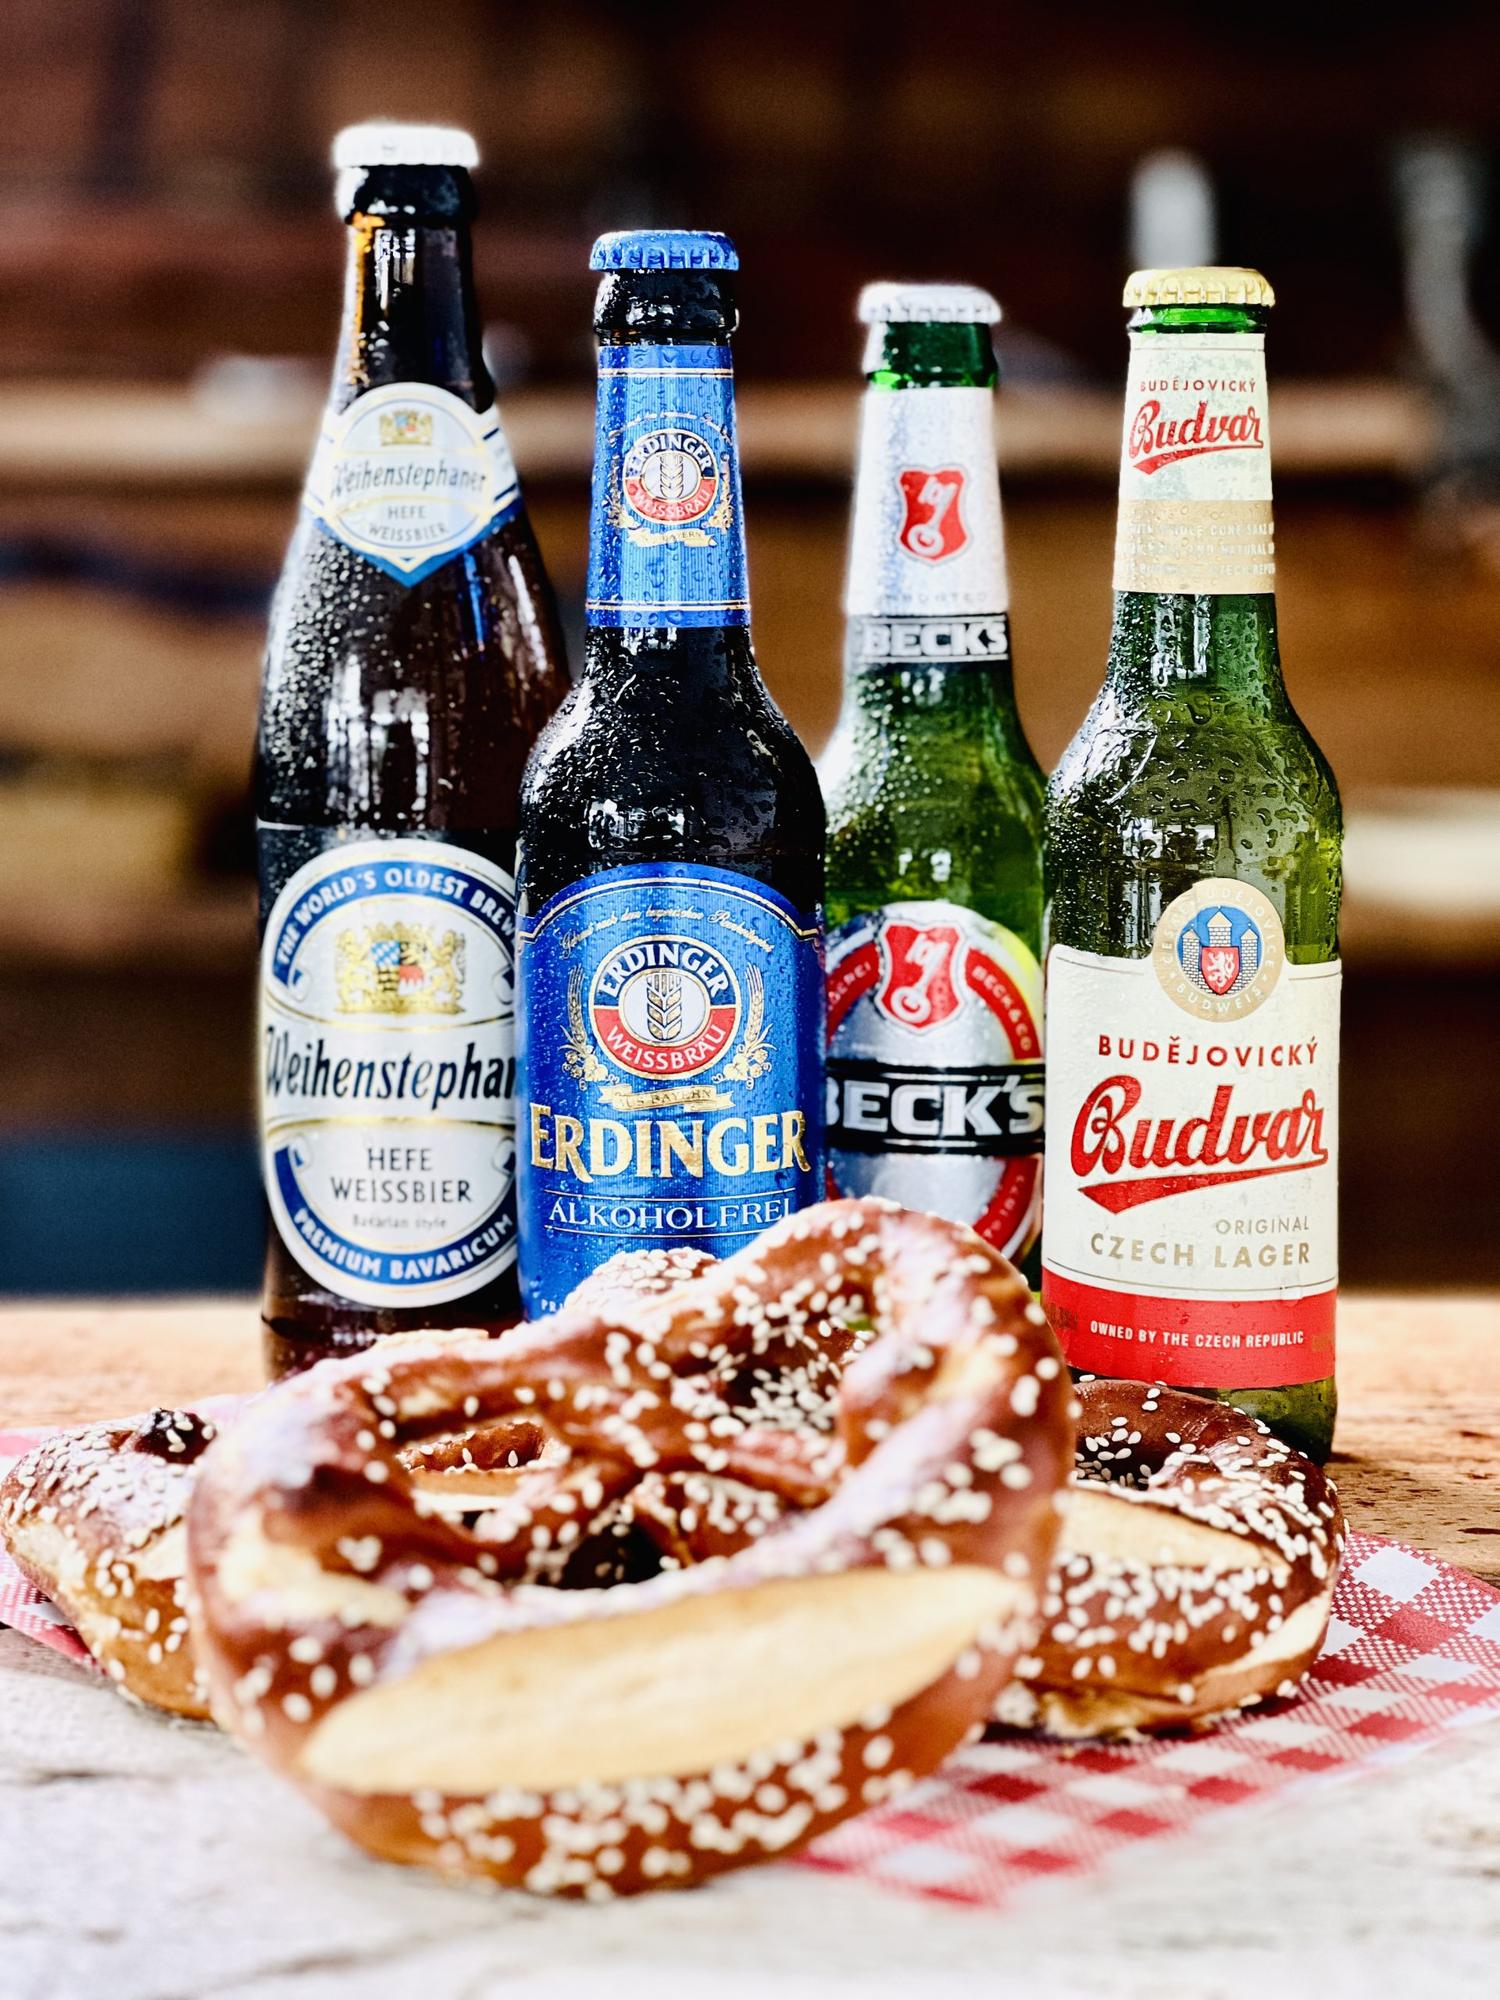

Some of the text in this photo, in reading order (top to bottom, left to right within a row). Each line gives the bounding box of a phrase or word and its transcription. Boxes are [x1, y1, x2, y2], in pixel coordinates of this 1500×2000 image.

[1129, 400, 1263, 459] Budvar
[628, 434, 713, 471] ERDINGER
[388, 505, 426, 519] HEFE
[368, 522, 449, 542] WEISSBIER
[277, 868, 516, 964] THE WORLD'S OLDEST BREW
[598, 943, 730, 998] ERDINGER
[1176, 983, 1262, 1014] BUDWEIS
[606, 1025, 727, 1070] WEISSBRÄU
[1098, 1034, 1318, 1067] BUDĚJOVICKÝ
[530, 1102, 811, 1184] ERDINGER
[1071, 1075, 1329, 1177] Budvar
[367, 1148, 433, 1171] HEFE
[330, 1177, 473, 1203] WEISSBIER
[548, 1197, 790, 1229] ALKOHOLFREI
[1216, 1215, 1310, 1235] ORIGINAL
[294, 1207, 514, 1280] PREMIUM BAVARICUM
[1091, 1233, 1310, 1268] CZECH LAGER
[1090, 1320, 1304, 1348] OWNED BY THE CZECH REPUBLIC
